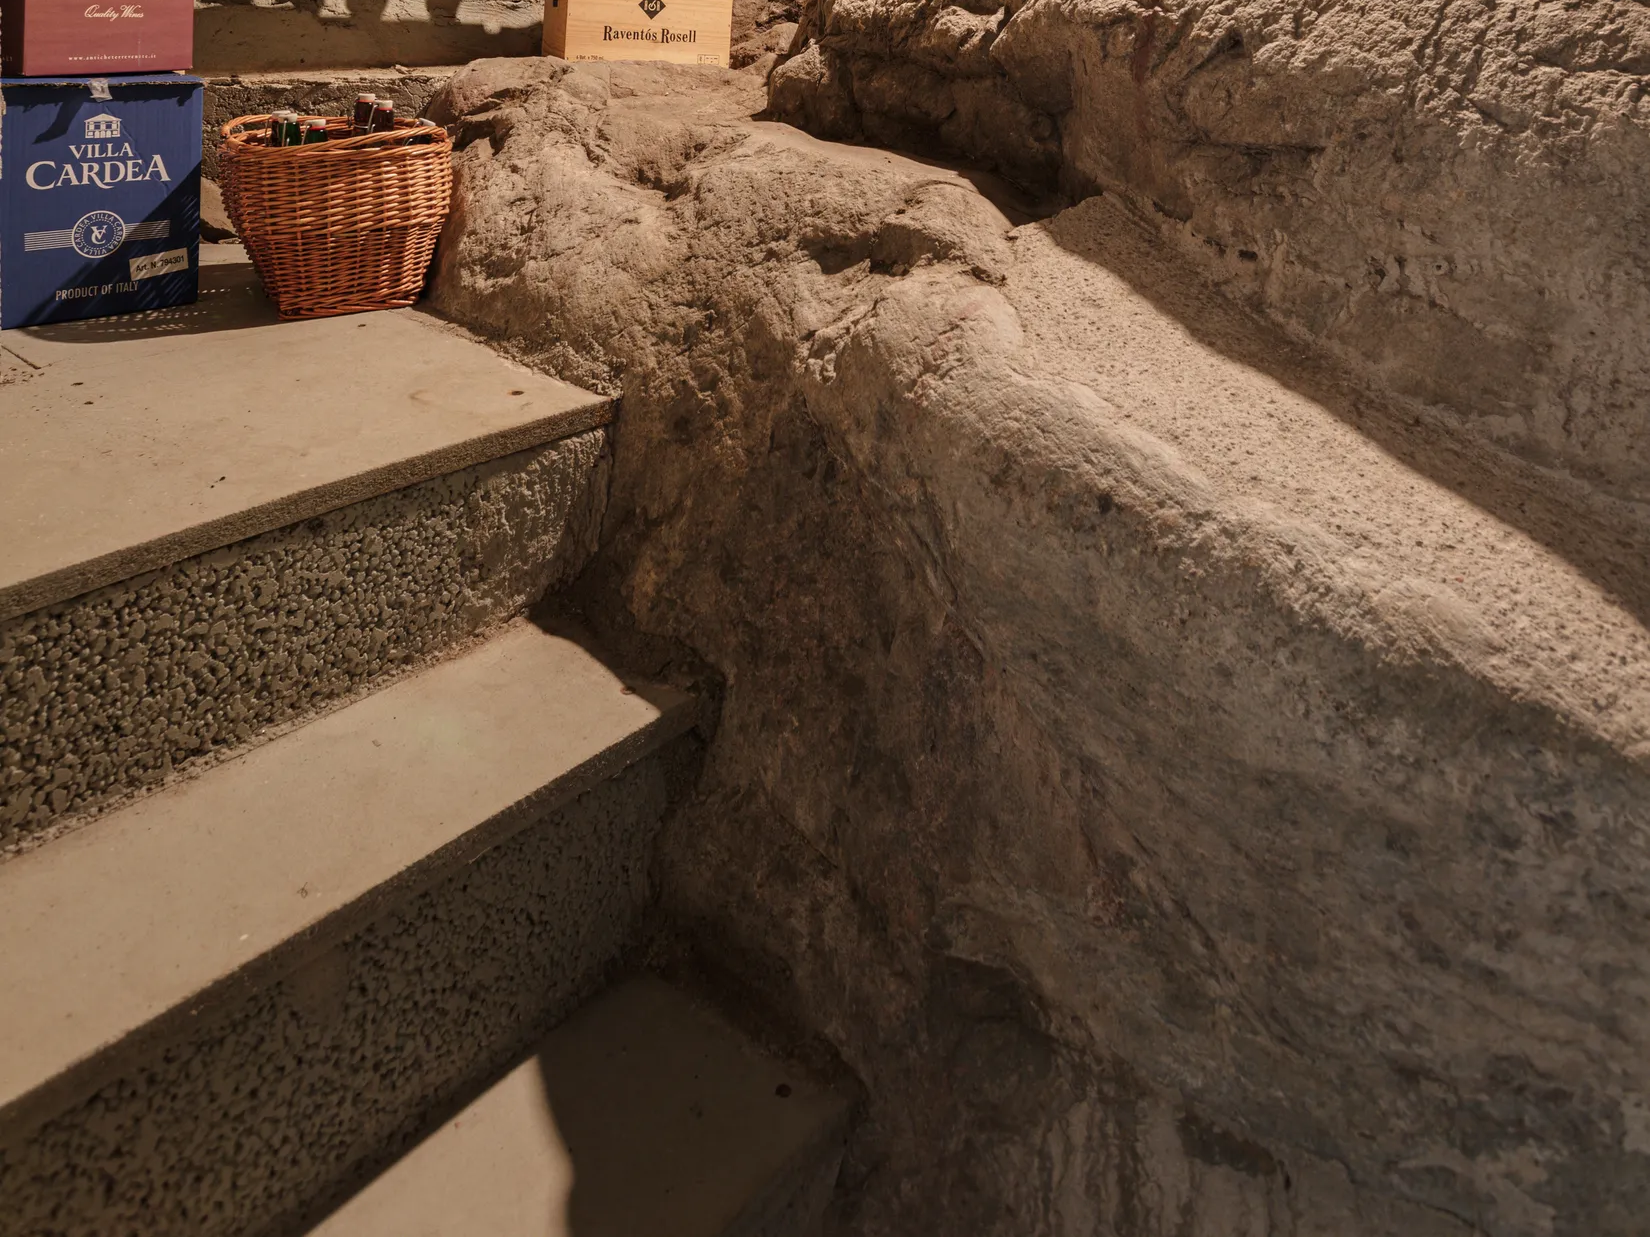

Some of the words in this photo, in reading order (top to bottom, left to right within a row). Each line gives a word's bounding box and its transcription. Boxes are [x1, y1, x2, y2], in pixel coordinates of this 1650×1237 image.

[84, 4, 120, 22] Quality
[120, 4, 145, 18] Wines
[603, 25, 658, 42] Raventós
[660, 28, 697, 44] Rosell
[68, 142, 134, 160] VILLA
[25, 154, 172, 190] CARDEA
[90, 213, 115, 222] VILLA
[74, 218, 90, 248] CARDEA
[109, 221, 123, 249] CARDEA
[83, 248, 107, 256] VILLA
[135, 264, 149, 273] Art.
[160, 255, 185, 268] 794301
[55, 285, 99, 301] PRODUCT
[101, 283, 113, 295] OF
[116, 281, 139, 294] ITALY
